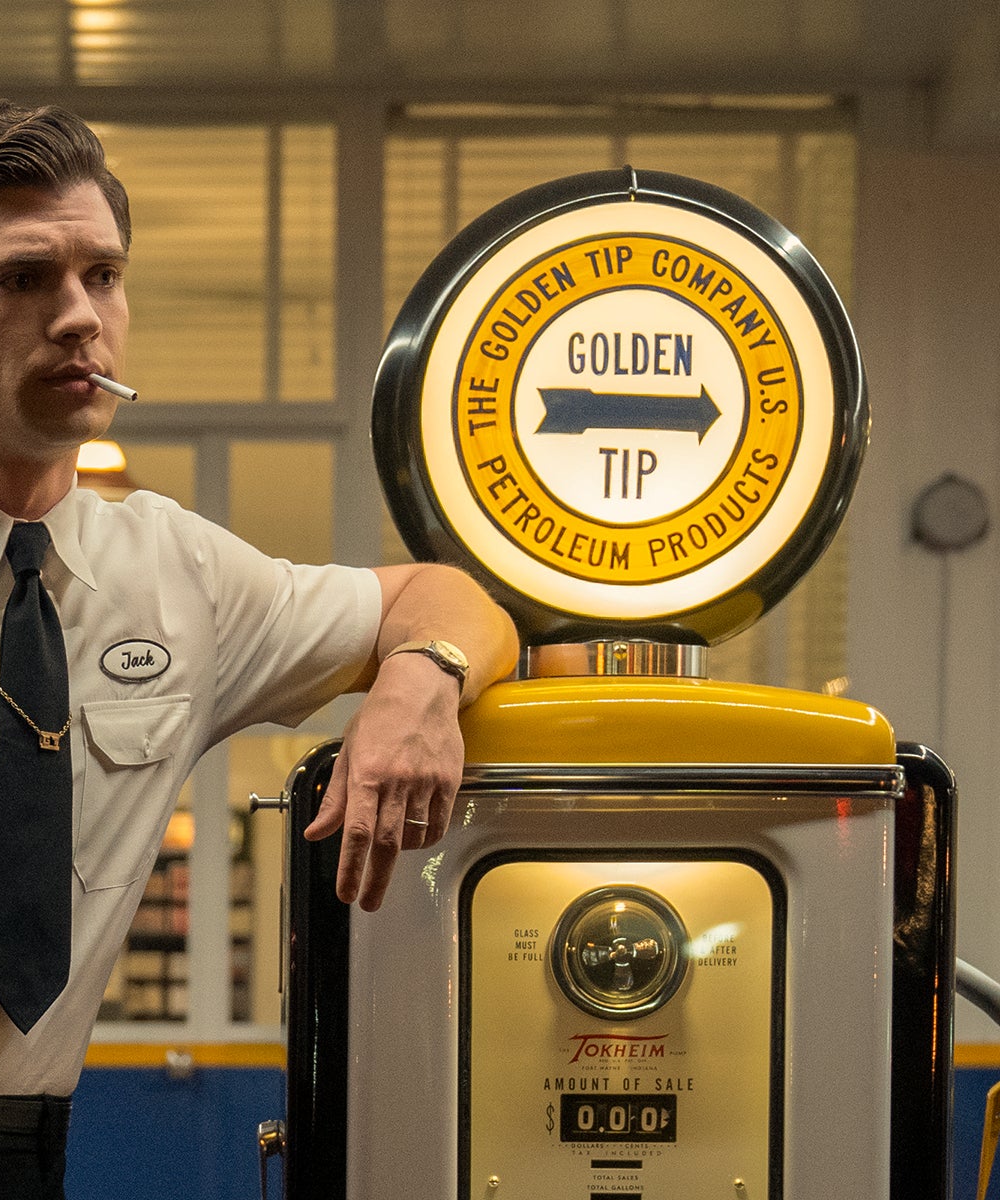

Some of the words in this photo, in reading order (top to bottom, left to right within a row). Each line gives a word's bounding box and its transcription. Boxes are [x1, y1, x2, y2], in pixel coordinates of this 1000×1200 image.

[584, 245, 633, 279] TIP
[479, 261, 577, 362] GOLDEN
[651, 248, 777, 351] COMPANY
[568, 332, 693, 377] GOLDEN
[467, 376, 500, 437] THE
[756, 365, 789, 424] U.S.
[598, 447, 658, 500] TIP
[476, 454, 631, 570] PETROLEUM
[648, 447, 779, 567] PRODUCTS
[121, 649, 155, 670] Jack
[513, 928, 539, 938] GLASS
[514, 941, 537, 950] MUST
[710, 945, 737, 955] AFTER
[507, 953, 519, 962] BE
[522, 953, 544, 962] FULL
[697, 957, 739, 967] DELIVERY
[567, 1033, 670, 1065] TOKHEIM
[543, 1077, 610, 1091] AMOUNT
[622, 1077, 642, 1092] OF
[654, 1077, 694, 1092] SALE
[545, 1101, 555, 1136] $
